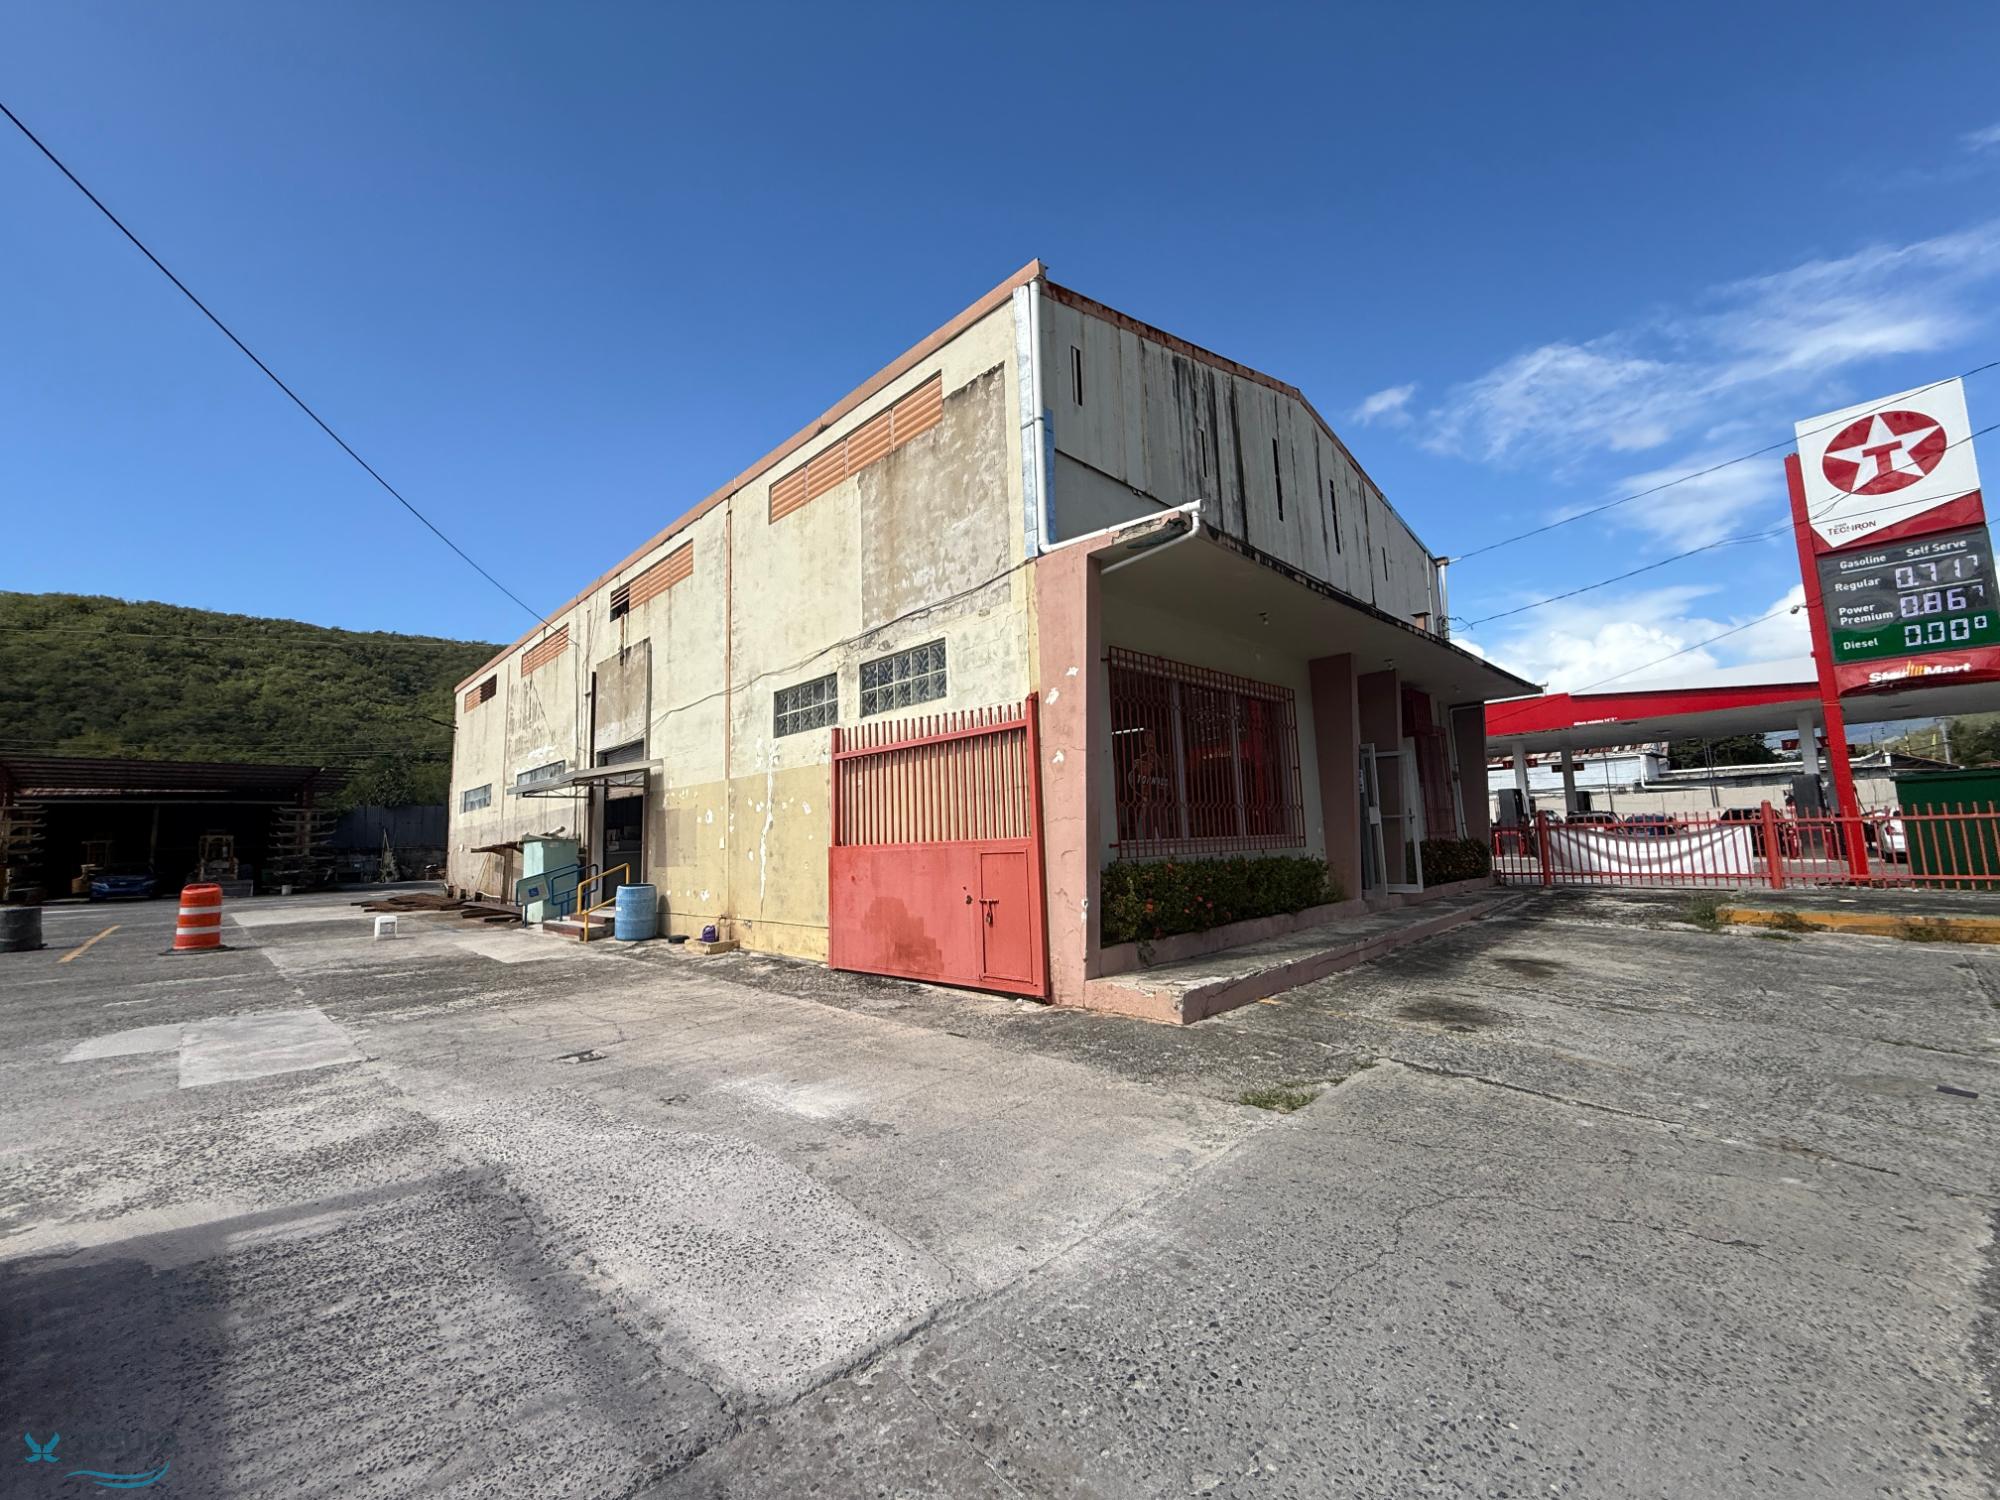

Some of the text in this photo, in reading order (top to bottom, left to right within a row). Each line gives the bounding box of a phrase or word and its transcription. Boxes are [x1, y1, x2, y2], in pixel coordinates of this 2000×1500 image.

[1840, 539, 1967, 569] Gasoline Self Serve
[1834, 577, 1881, 592] Regular
[1838, 603, 1876, 616] Power
[1840, 611, 1894, 626] Premium
[1843, 637, 1879, 650] Diesel
